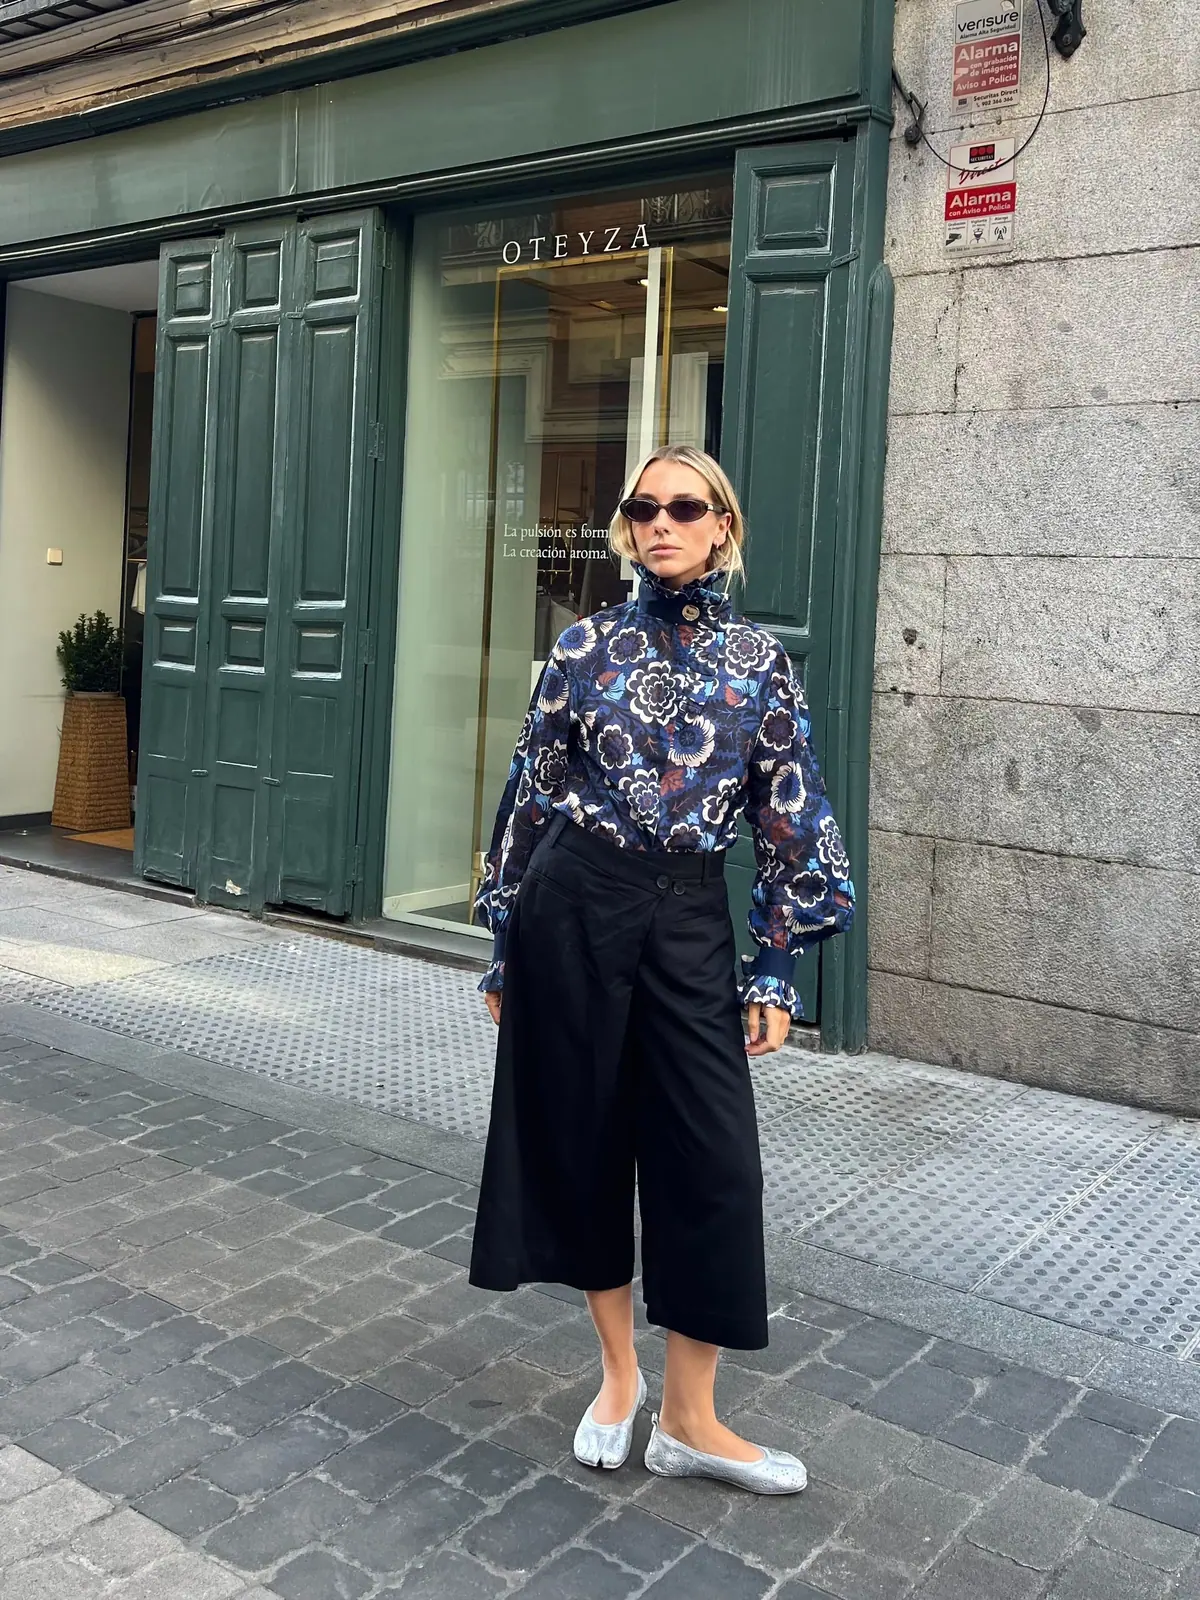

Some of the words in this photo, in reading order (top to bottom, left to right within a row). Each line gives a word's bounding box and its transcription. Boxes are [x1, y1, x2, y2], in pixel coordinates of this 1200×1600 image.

[958, 11, 1019, 32] verisure
[990, 23, 1016, 33] Seguridad
[957, 41, 1018, 62] Alarma
[970, 69, 980, 77] de
[981, 62, 1017, 75] imágenes
[984, 55, 1017, 68] grabación
[955, 81, 979, 91] Aviso
[989, 73, 1017, 85] Policía
[973, 92, 999, 101] Securitas
[1000, 88, 1018, 96] Direct
[949, 191, 1012, 209] Alarma
[962, 205, 981, 215] Aviso
[988, 203, 1011, 211] Policía
[502, 223, 650, 264] OTEYZA
[504, 523, 518, 537] La
[520, 523, 562, 541] pulsión
[565, 528, 577, 538] es
[581, 523, 609, 538] form
[503, 543, 517, 558] La
[520, 545, 566, 559] creación
[570, 549, 609, 559] aroma.
